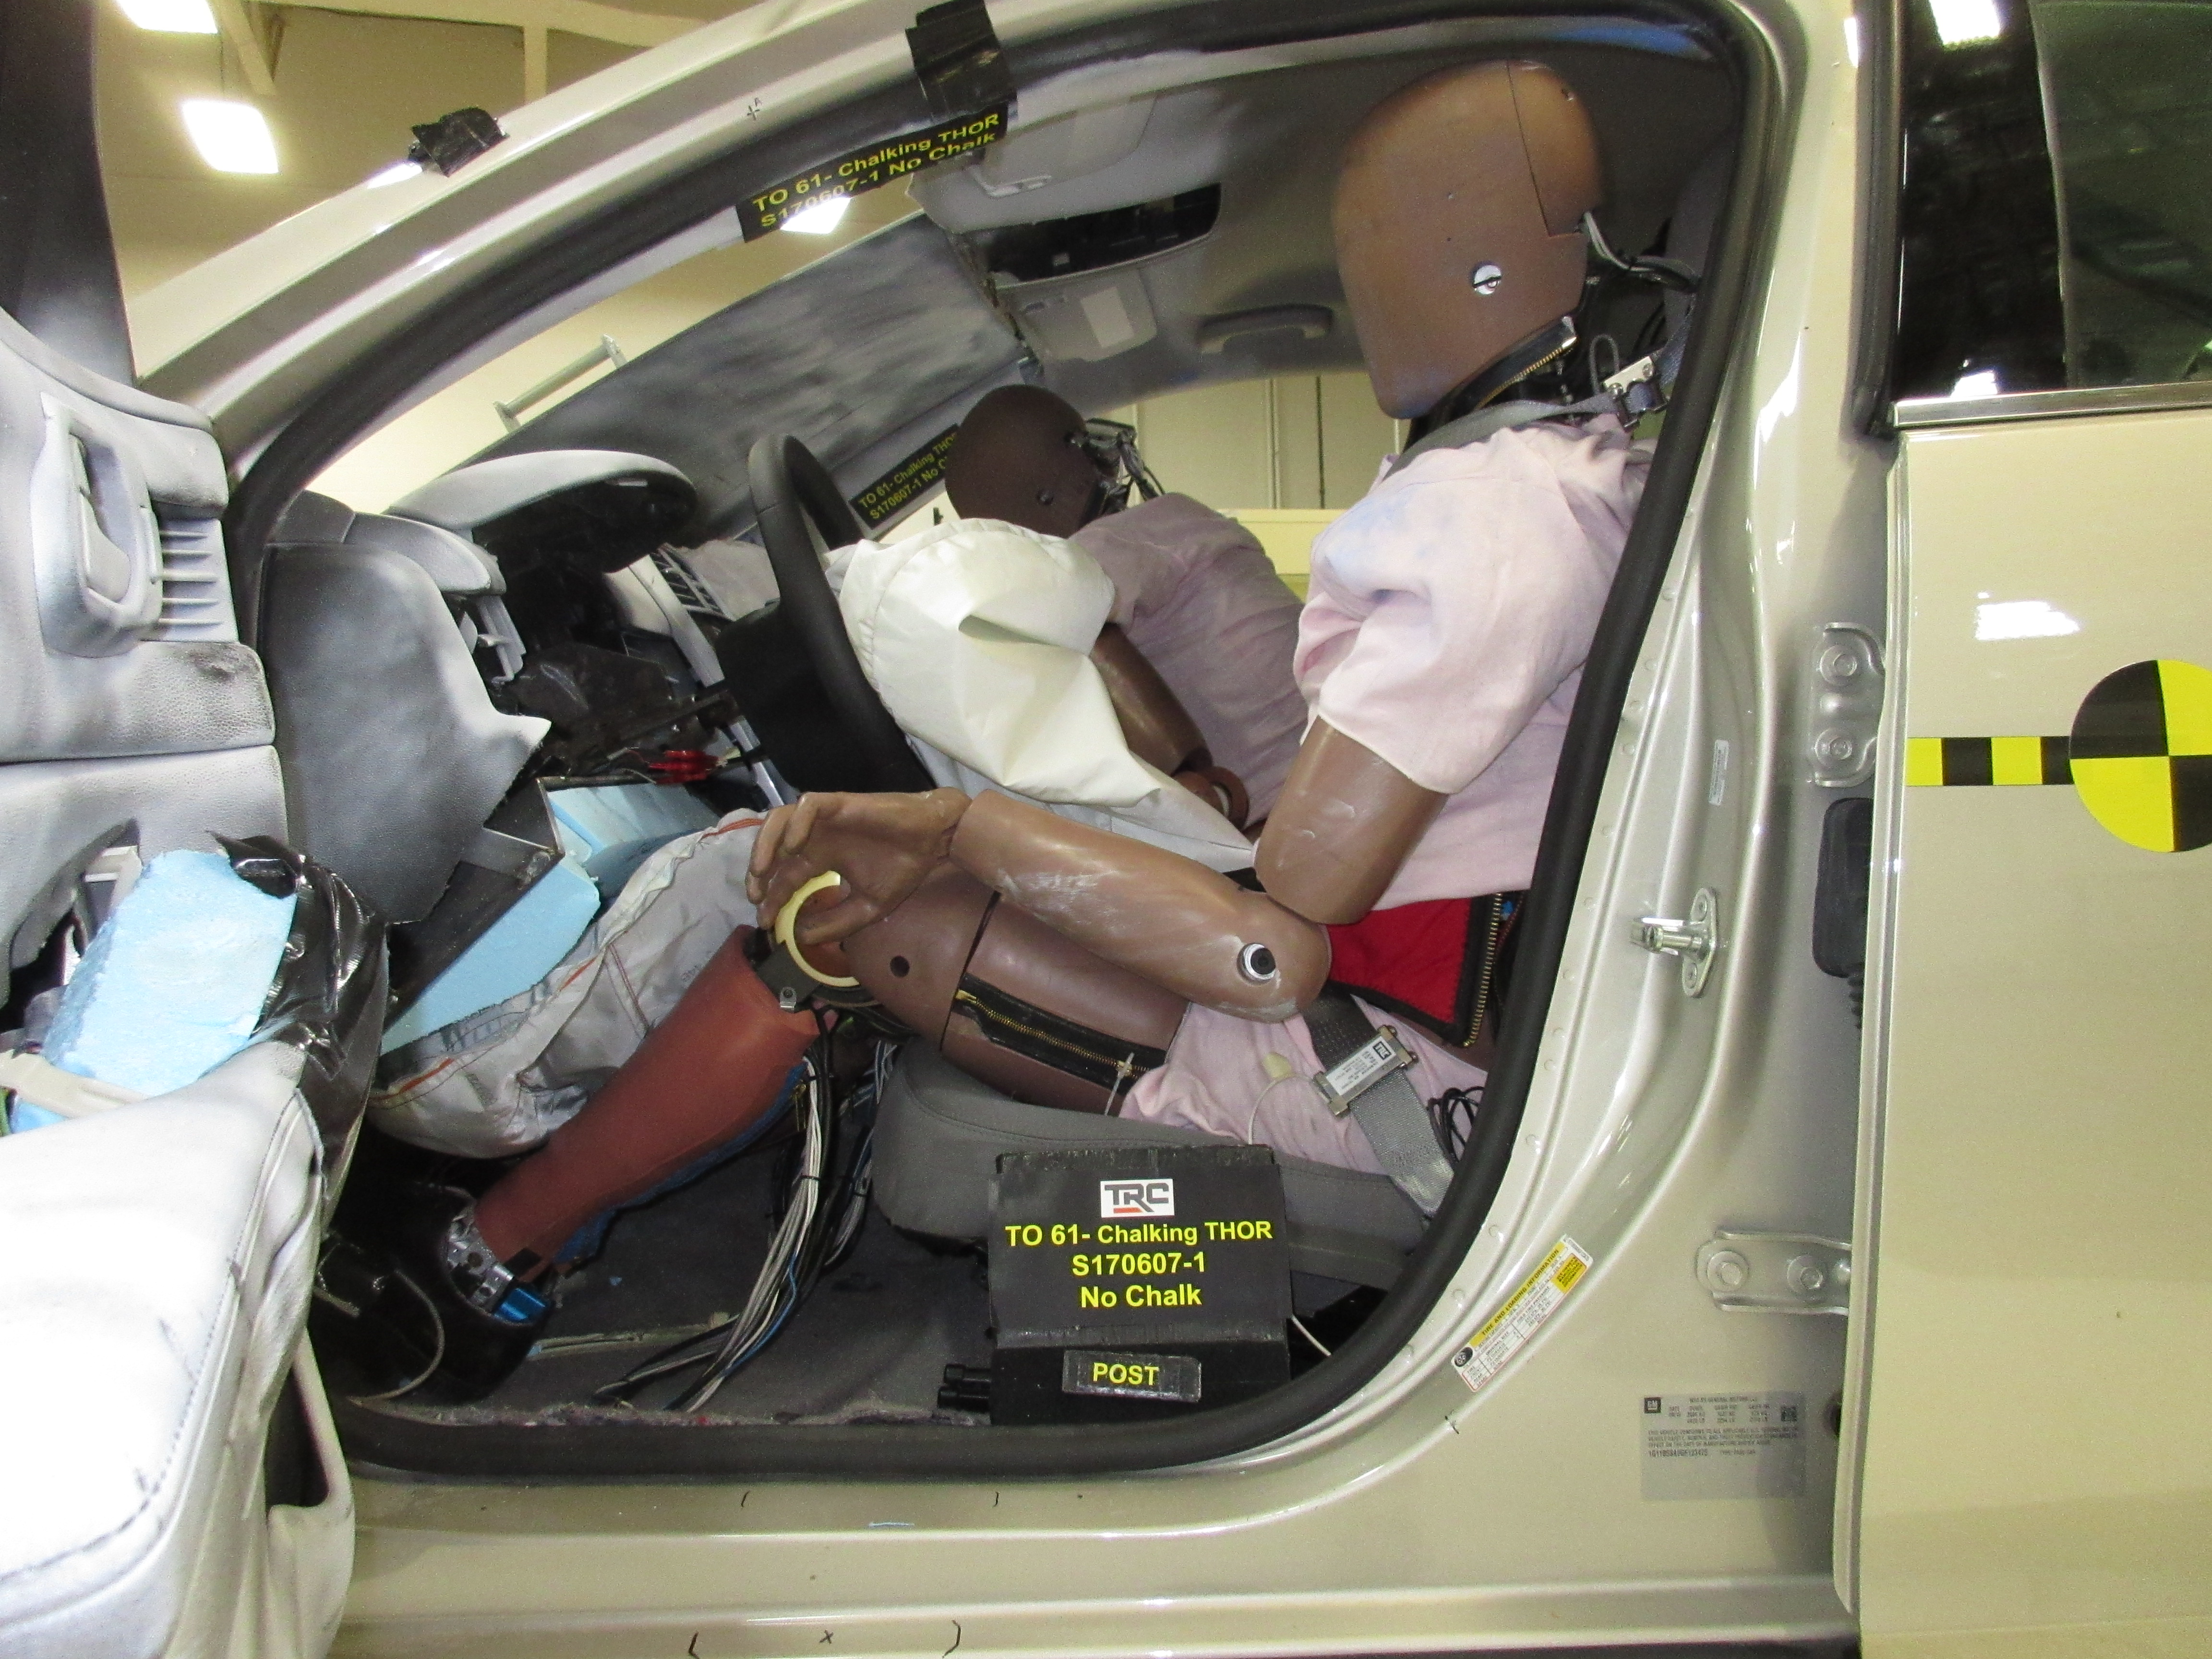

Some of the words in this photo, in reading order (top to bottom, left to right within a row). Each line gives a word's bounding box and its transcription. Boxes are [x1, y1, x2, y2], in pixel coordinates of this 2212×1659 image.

[753, 188, 788, 212] TO
[795, 172, 832, 193] 61-
[838, 138, 931, 177] Chalking
[938, 113, 999, 142] THOR
[889, 159, 921, 176] No
[929, 132, 996, 161] Chalk
[858, 493, 876, 508] TO
[894, 453, 935, 484] Chalking
[921, 468, 938, 481] No
[1105, 1183, 1169, 1213] TRC
[1005, 1225, 1043, 1247] TO
[1051, 1223, 1090, 1245] 61-
[1098, 1223, 1198, 1246] Chalking
[1204, 1221, 1274, 1240] THOR
[1072, 1251, 1205, 1276] S170607-1
[1081, 1286, 1118, 1308] No
[1126, 1284, 1202, 1307] Chalk
[1492, 1309, 1506, 1323] AND
[1503, 1285, 1527, 1311] LOADING
[1525, 1249, 1560, 1286] INFORMATION
[1093, 1362, 1160, 1385] POST
